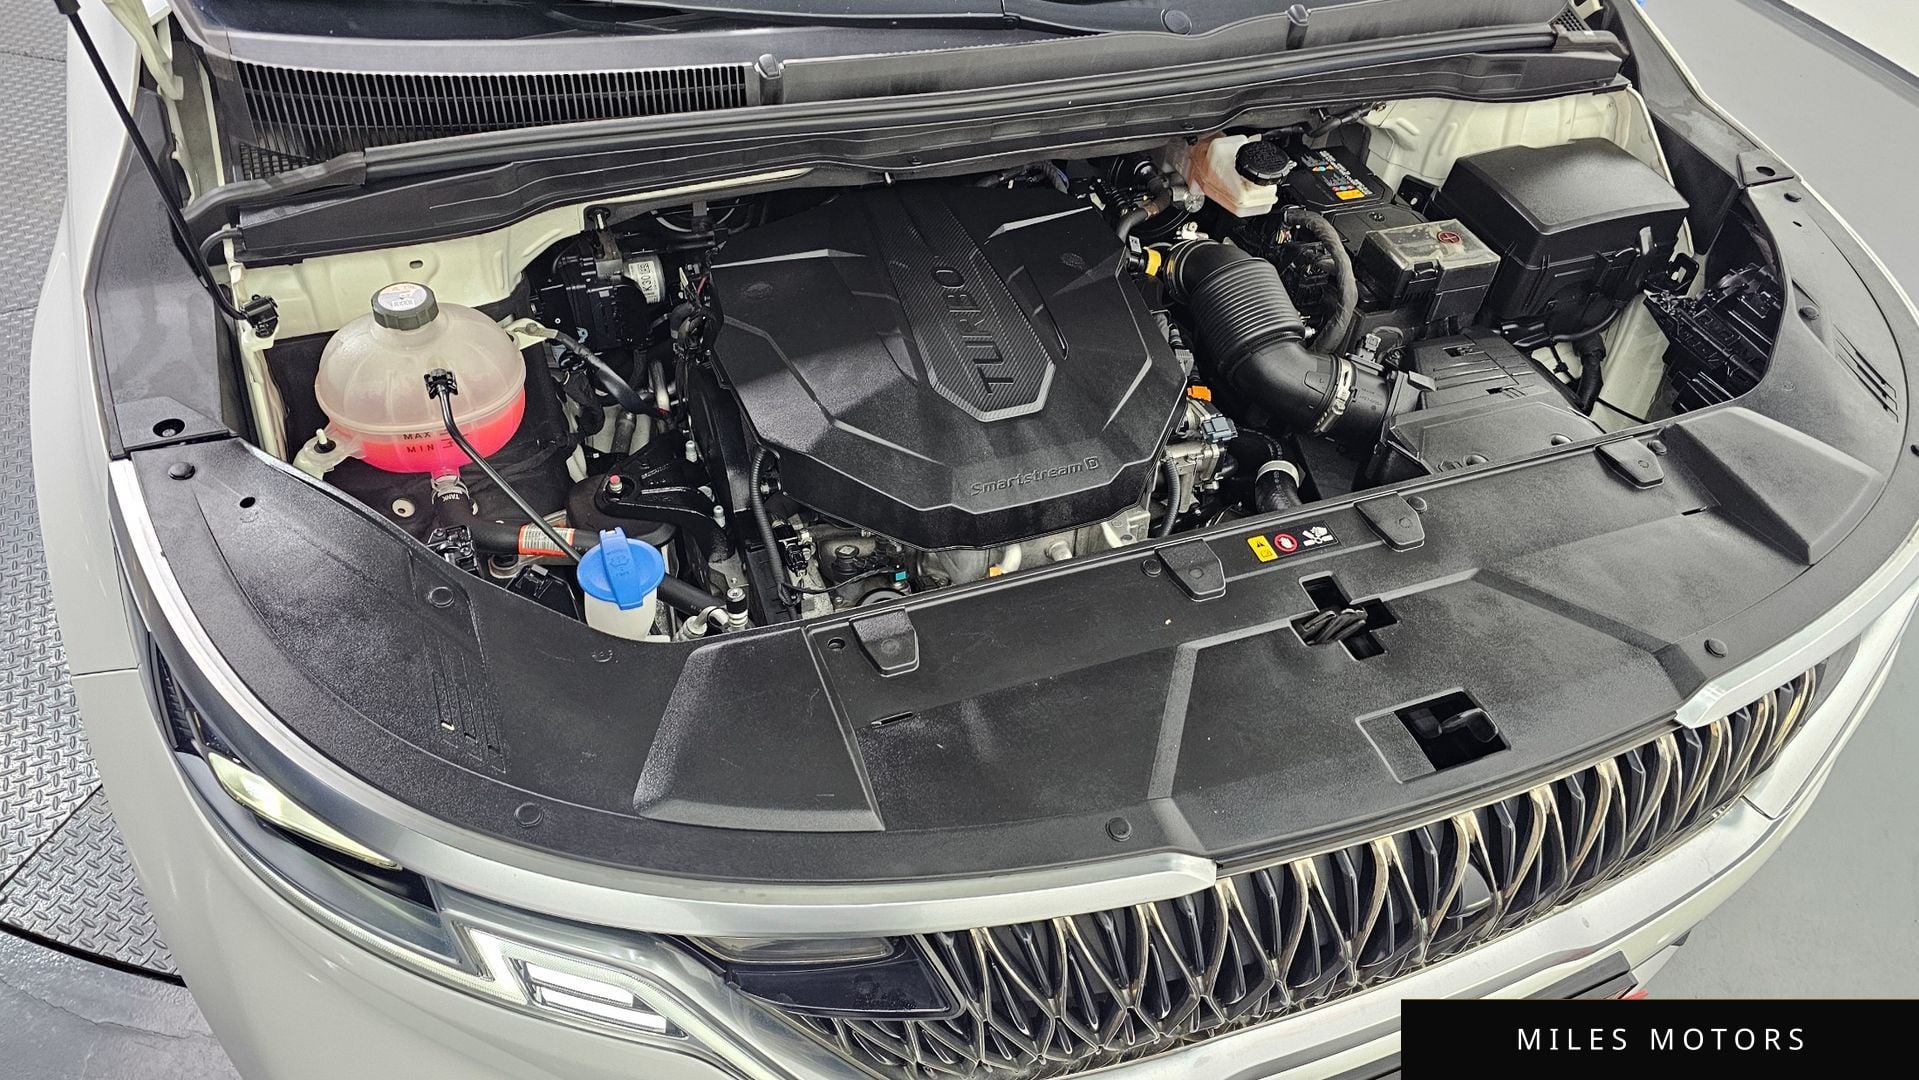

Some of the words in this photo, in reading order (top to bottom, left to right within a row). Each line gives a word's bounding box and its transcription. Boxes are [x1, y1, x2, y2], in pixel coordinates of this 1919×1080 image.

[931, 266, 1015, 396] TURBO
[403, 431, 431, 441] MAX
[406, 443, 435, 453] MIN
[970, 462, 1083, 497] Smartstream
[441, 493, 460, 502] TANK
